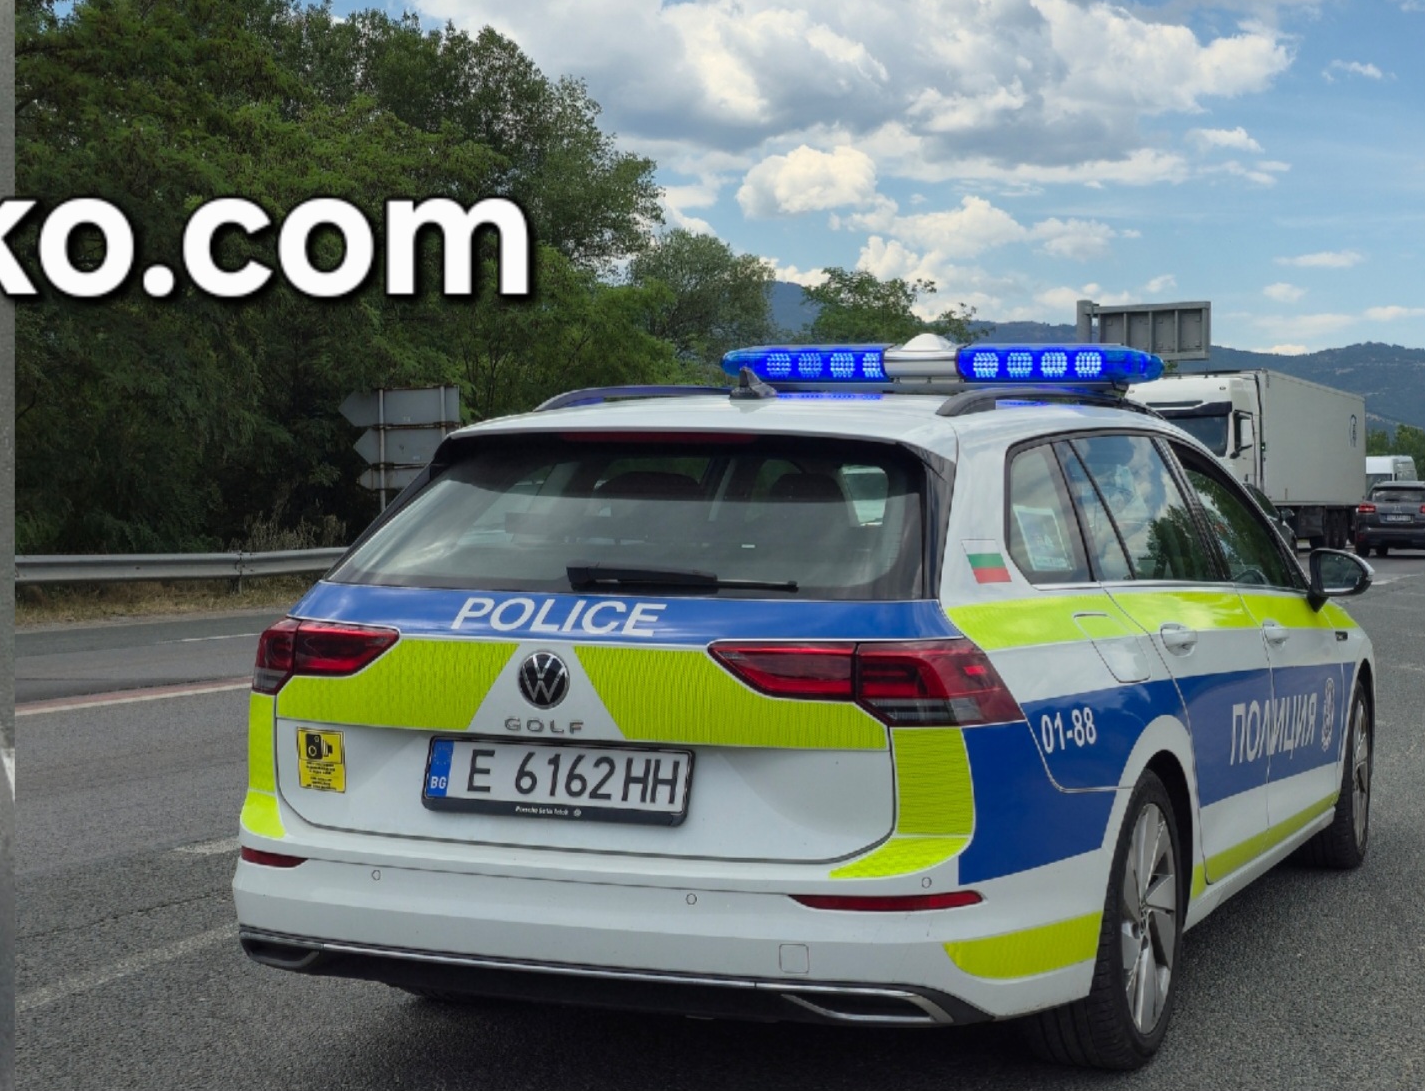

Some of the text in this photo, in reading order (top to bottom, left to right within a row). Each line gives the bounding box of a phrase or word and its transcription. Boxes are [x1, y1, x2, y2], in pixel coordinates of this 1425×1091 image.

[451, 597, 668, 637] POLICE
[504, 718, 585, 734] GOLF
[1041, 707, 1097, 754] 01-88
[1230, 692, 1318, 766] ПОЛИЦИЯ
[430, 774, 447, 790] BG
